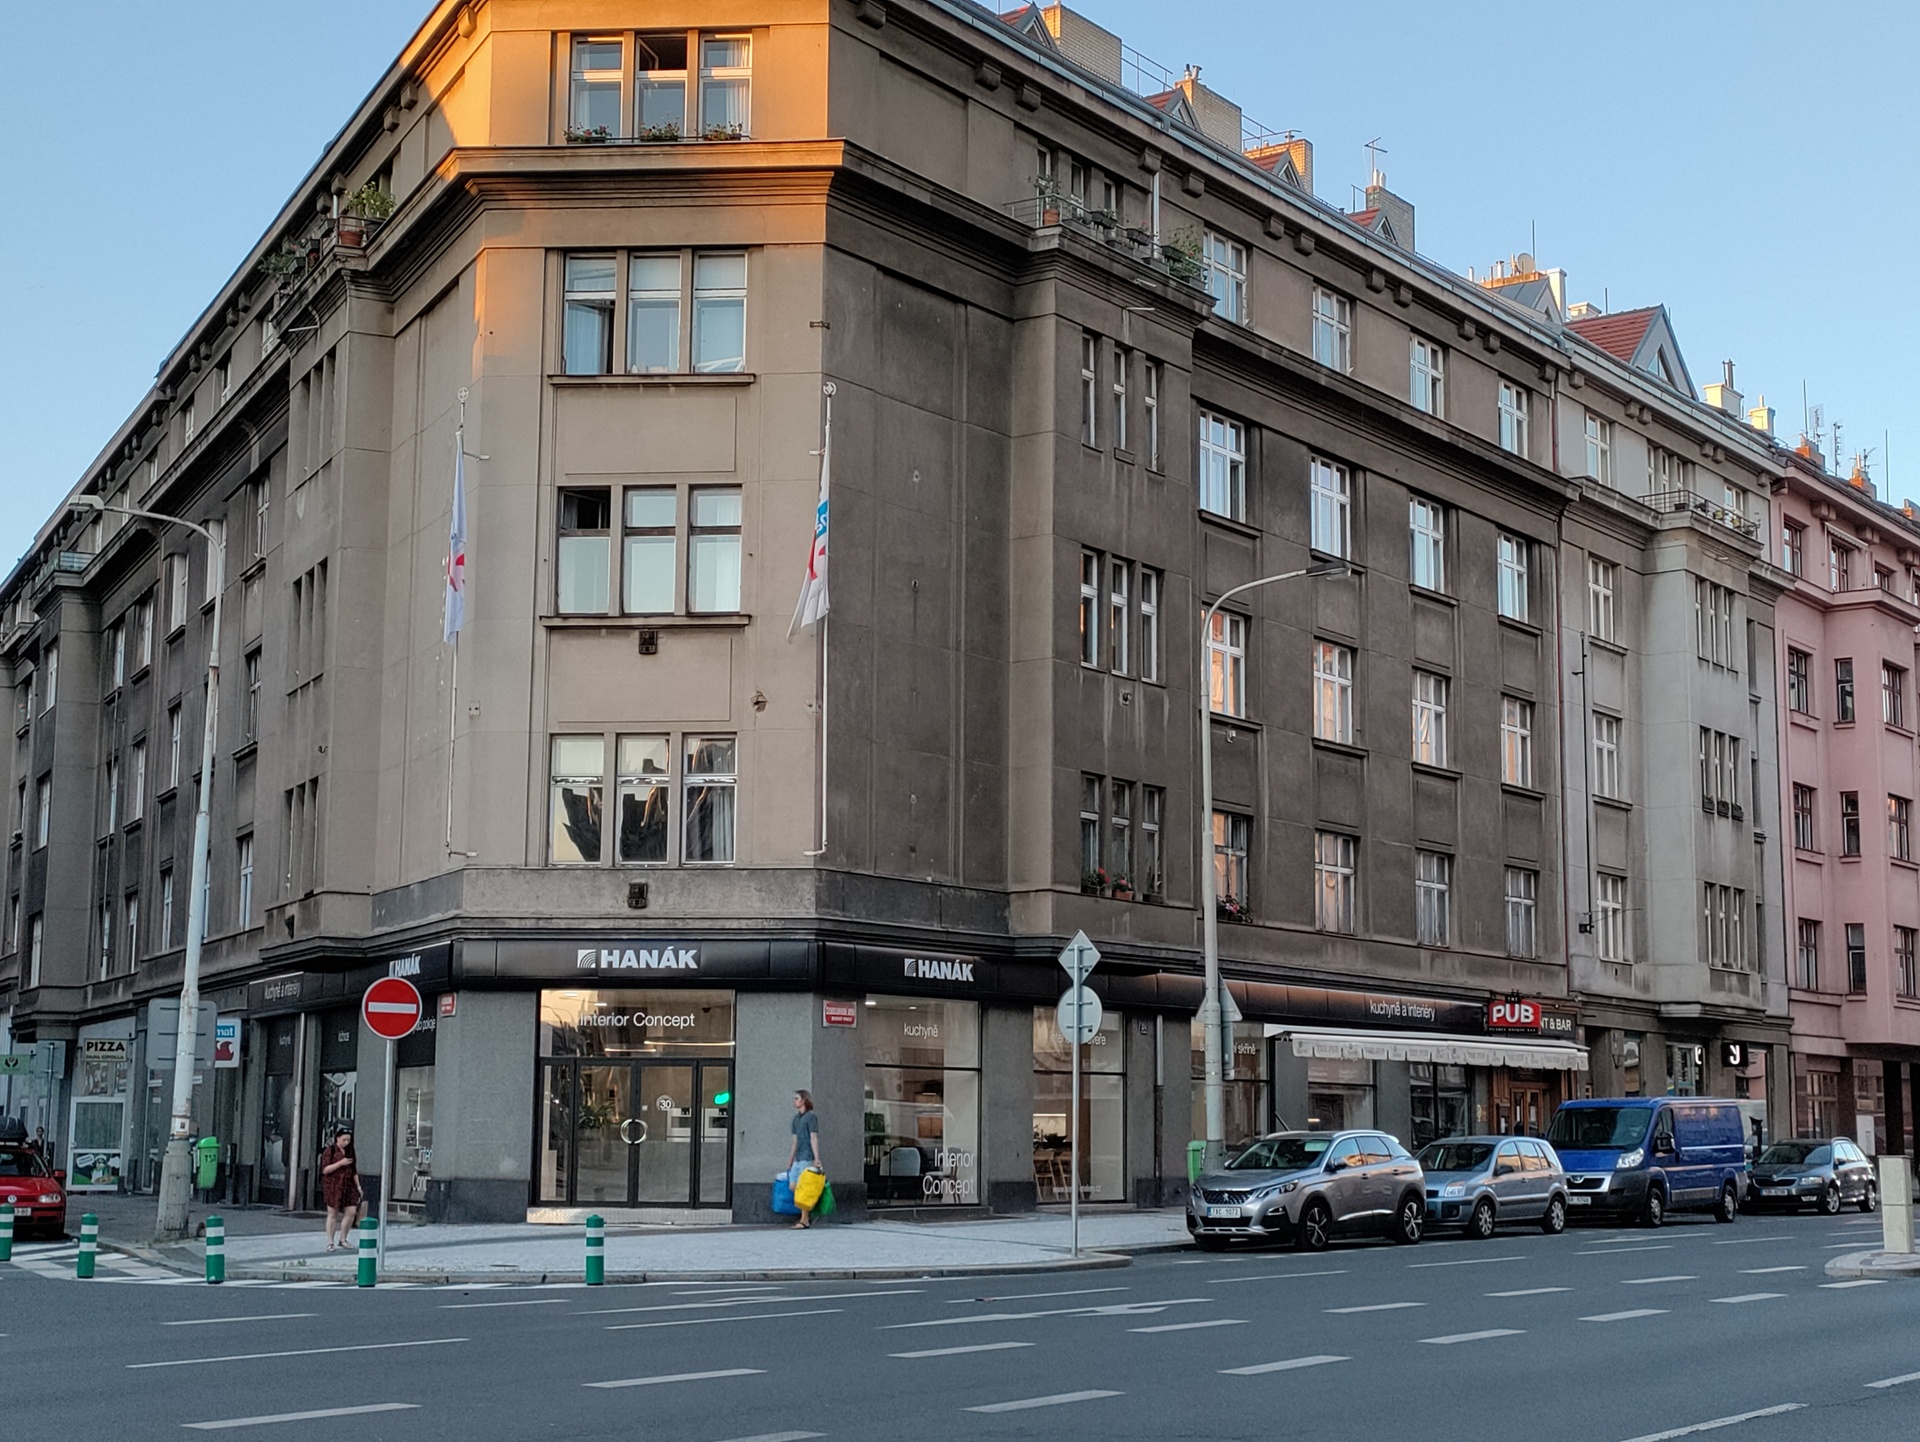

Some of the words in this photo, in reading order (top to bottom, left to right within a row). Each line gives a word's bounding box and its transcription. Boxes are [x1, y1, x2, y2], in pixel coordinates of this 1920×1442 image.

[600, 946, 698, 969] HANÁK
[918, 959, 974, 982] HANÁK
[1370, 999, 1400, 1018] kuchyně
[1401, 1005, 1408, 1016] a
[1408, 1003, 1435, 1021] interiéry
[1493, 1003, 1534, 1023] PUB
[580, 1012, 629, 1027] Interior
[633, 1012, 695, 1029] Concept
[1556, 1019, 1571, 1031] BAR
[904, 1022, 938, 1039] kuchyně
[86, 1041, 125, 1052] PIZZA
[660, 1100, 672, 1109] 30
[934, 1148, 975, 1167] Interior
[922, 1175, 974, 1198] Concept
